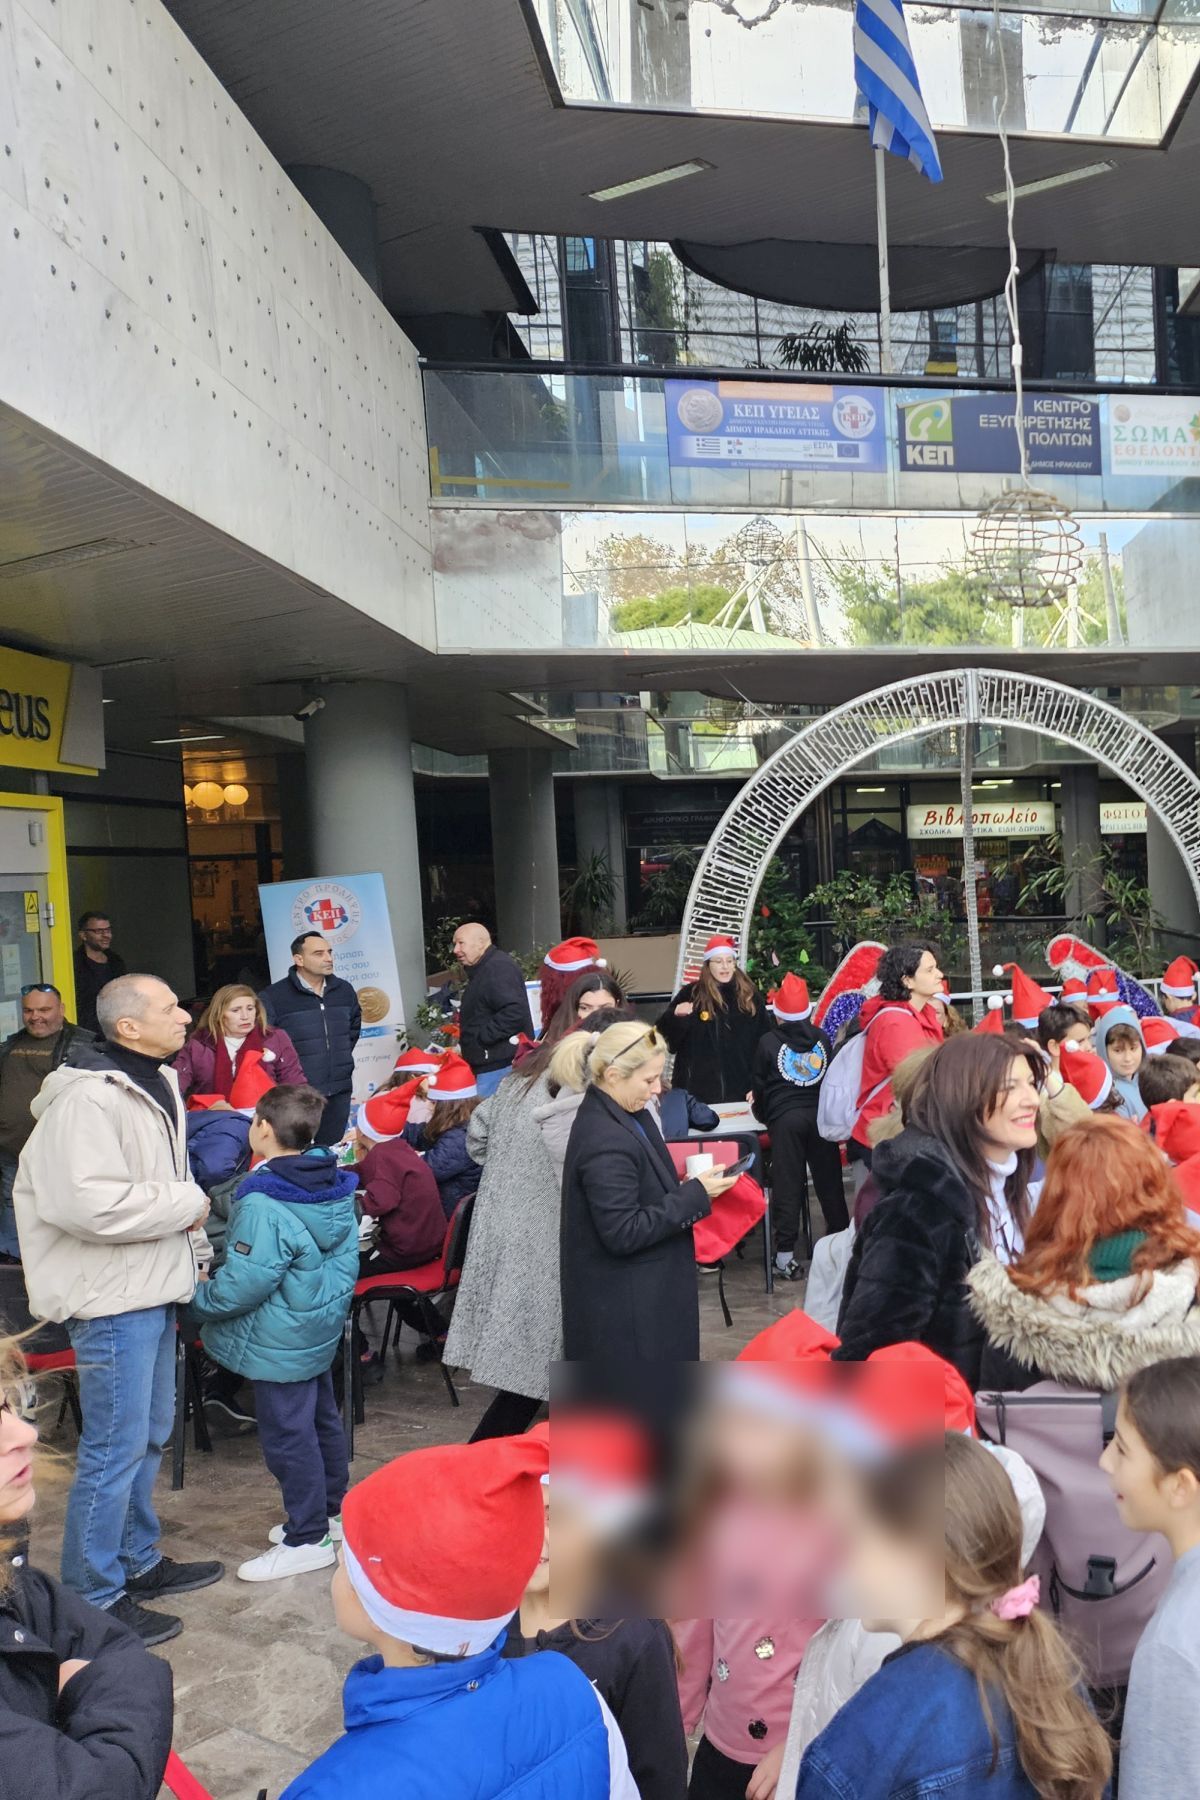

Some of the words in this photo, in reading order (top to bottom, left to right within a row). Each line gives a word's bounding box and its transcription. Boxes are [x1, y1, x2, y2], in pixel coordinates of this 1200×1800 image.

[734, 403, 764, 418] ΚΕΠ
[769, 405, 820, 420] ΥΓΕΙΑΣ
[1033, 399, 1091, 414] ΚΕΝΤΡΟ
[725, 425, 753, 434] ΔΗΜΟΥ
[1113, 425, 1188, 443] ΣΩΜΑ
[1029, 432, 1092, 447] ΠΟΛΙΤΩΝ
[906, 445, 954, 466] ΚΕΠ
[0, 688, 51, 740] eus
[923, 807, 1038, 826] Βιβλοπωλείο
[1103, 808, 1147, 819] ΦΩΤΟ
[919, 828, 952, 836] ΣΧΟΛΙΚΑ
[313, 909, 341, 921] ΚΕΠ
